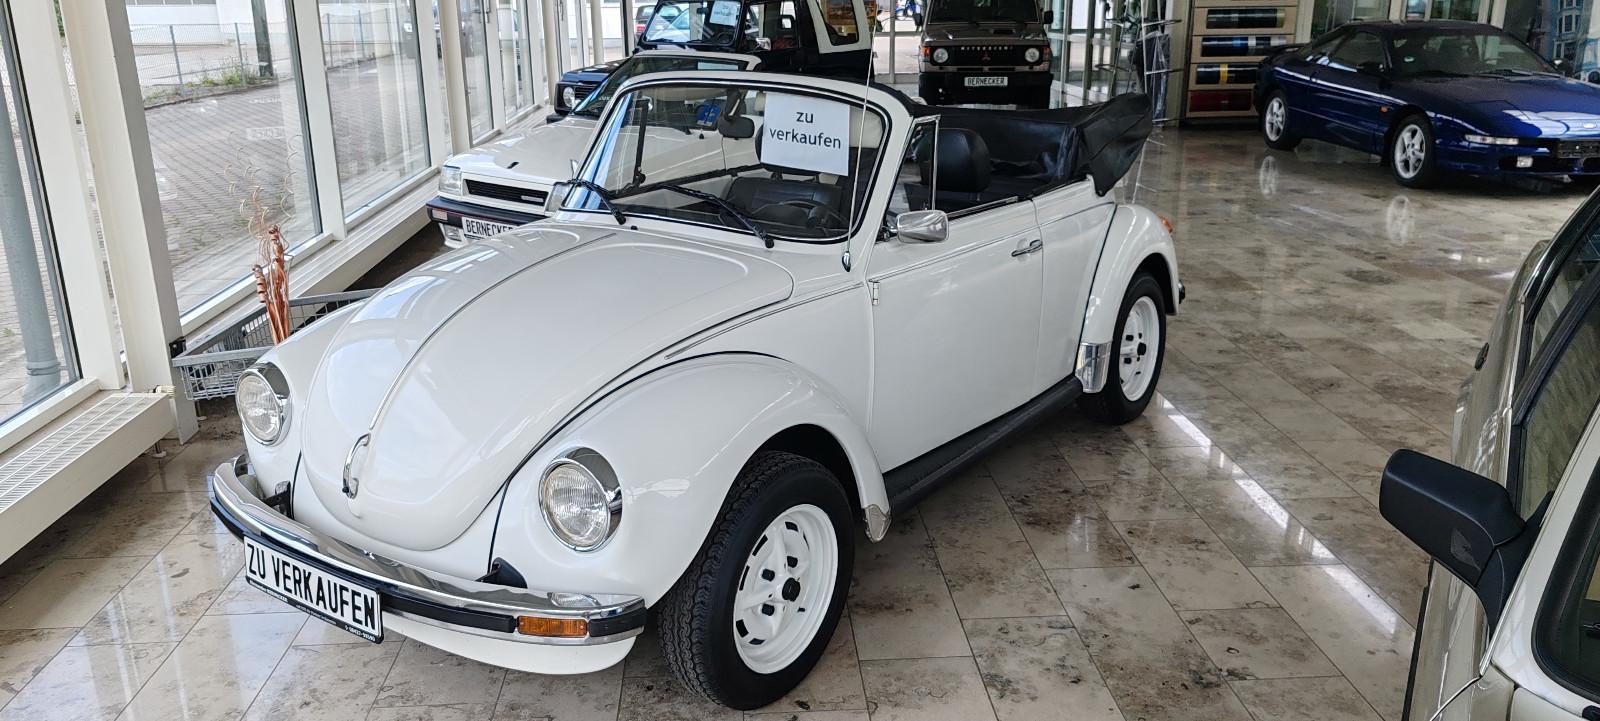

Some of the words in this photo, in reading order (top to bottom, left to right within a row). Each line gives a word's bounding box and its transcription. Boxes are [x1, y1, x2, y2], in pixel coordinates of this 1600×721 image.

[967, 77, 1005, 86] BERNECKER
[796, 111, 815, 124] zu
[769, 128, 841, 149] verkaufen
[247, 543, 266, 578] ZU
[271, 554, 375, 630] VERKAUFEN
